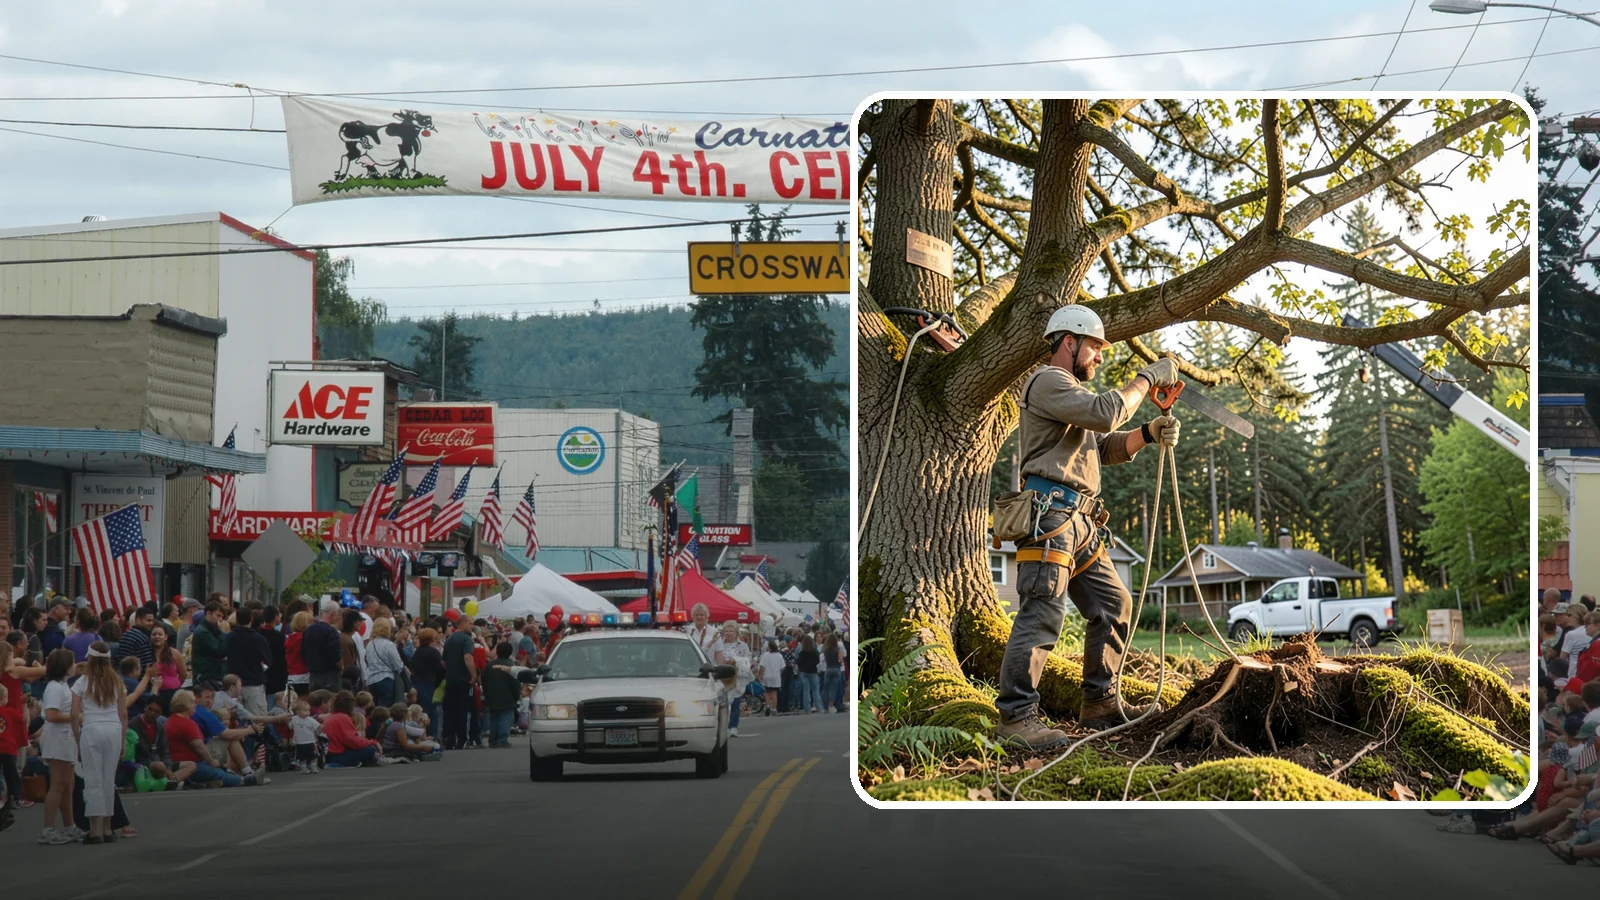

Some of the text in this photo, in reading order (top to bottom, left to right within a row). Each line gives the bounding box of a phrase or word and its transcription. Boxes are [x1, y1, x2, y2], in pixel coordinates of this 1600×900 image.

[481, 141, 605, 192] JULY
[632, 149, 746, 197] 4th.
[697, 254, 850, 280] CROSSWA
[283, 380, 373, 420] ACE
[405, 409, 452, 422] CEDAR
[283, 421, 370, 436] Hardware
[95, 485, 124, 495] Vincent
[126, 486, 136, 495] de
[137, 486, 155, 495] Paul
[688, 526, 741, 535] CRNATION
[699, 535, 730, 543] GLASS
